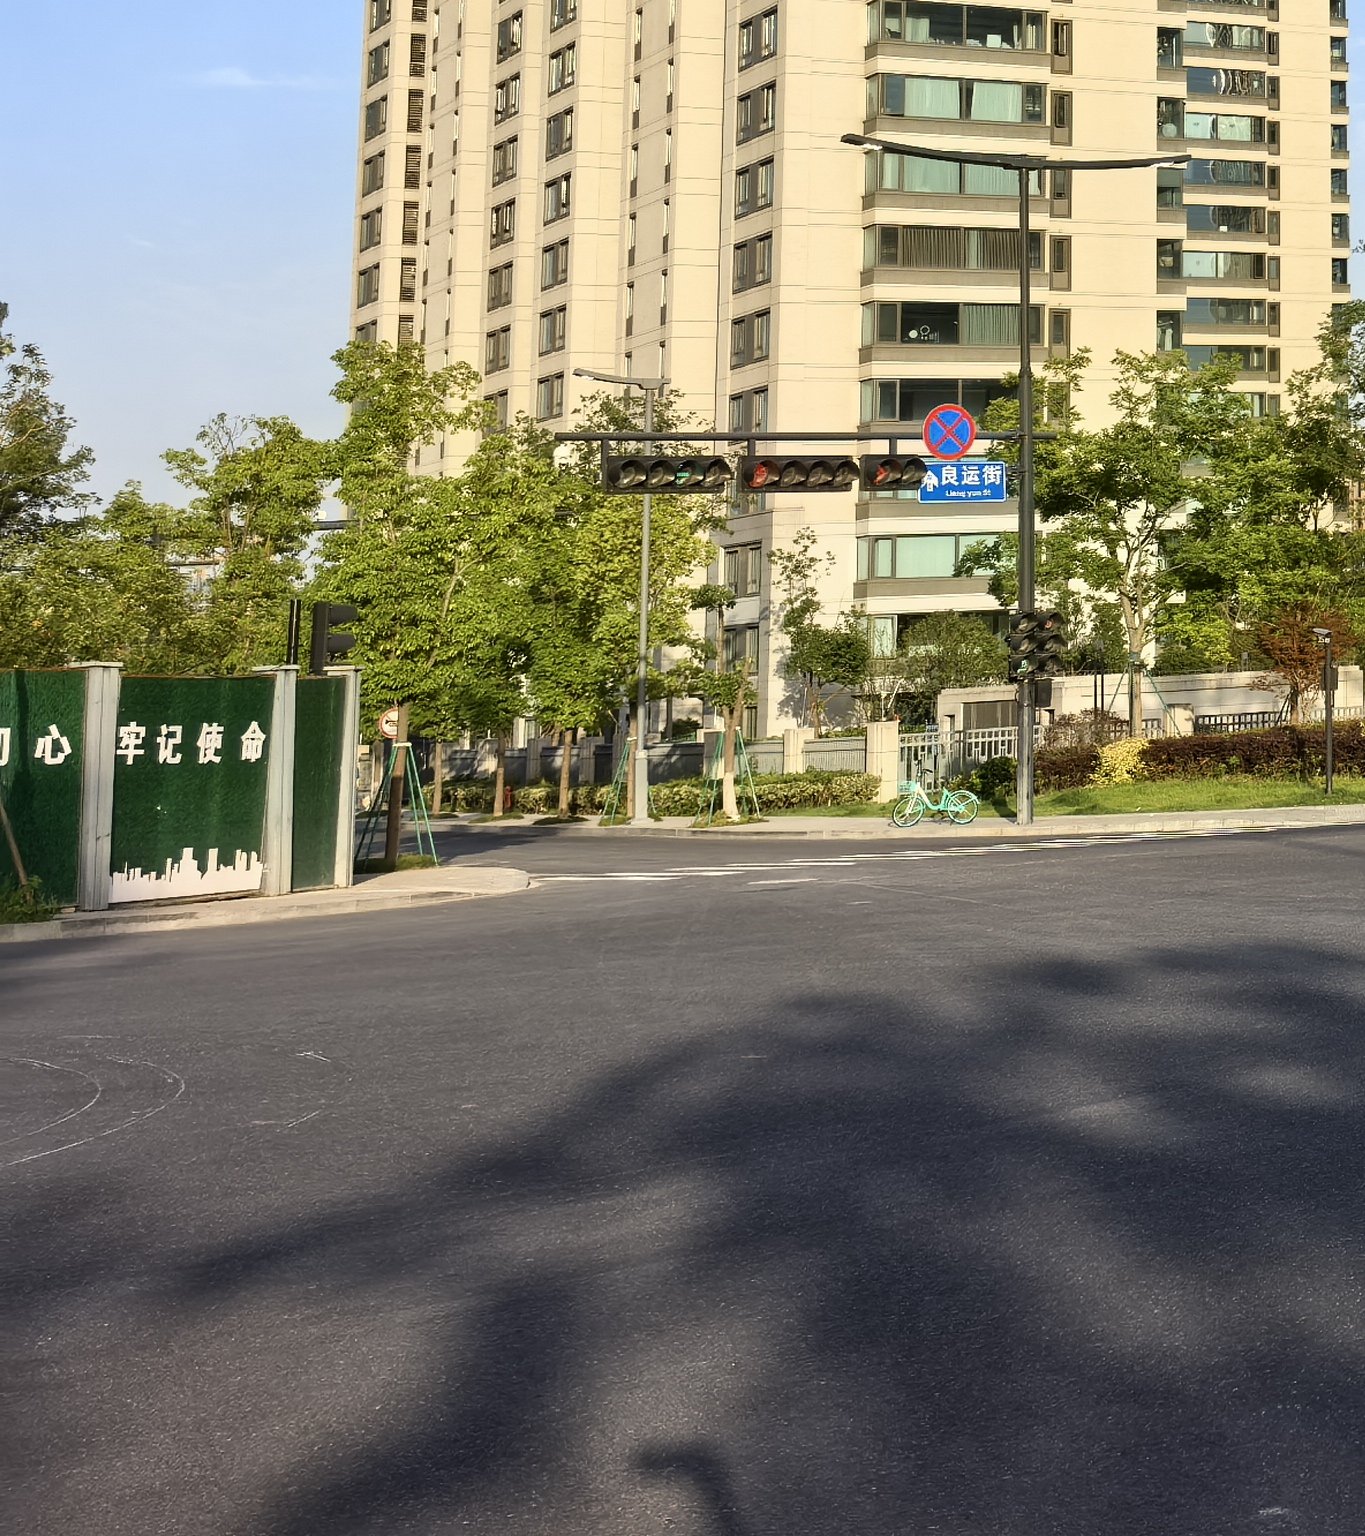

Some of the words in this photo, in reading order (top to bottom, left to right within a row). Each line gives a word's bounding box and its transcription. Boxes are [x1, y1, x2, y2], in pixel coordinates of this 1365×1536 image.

[941, 465, 1002, 486] 良运街
[116, 720, 267, 766] 牢记使命
